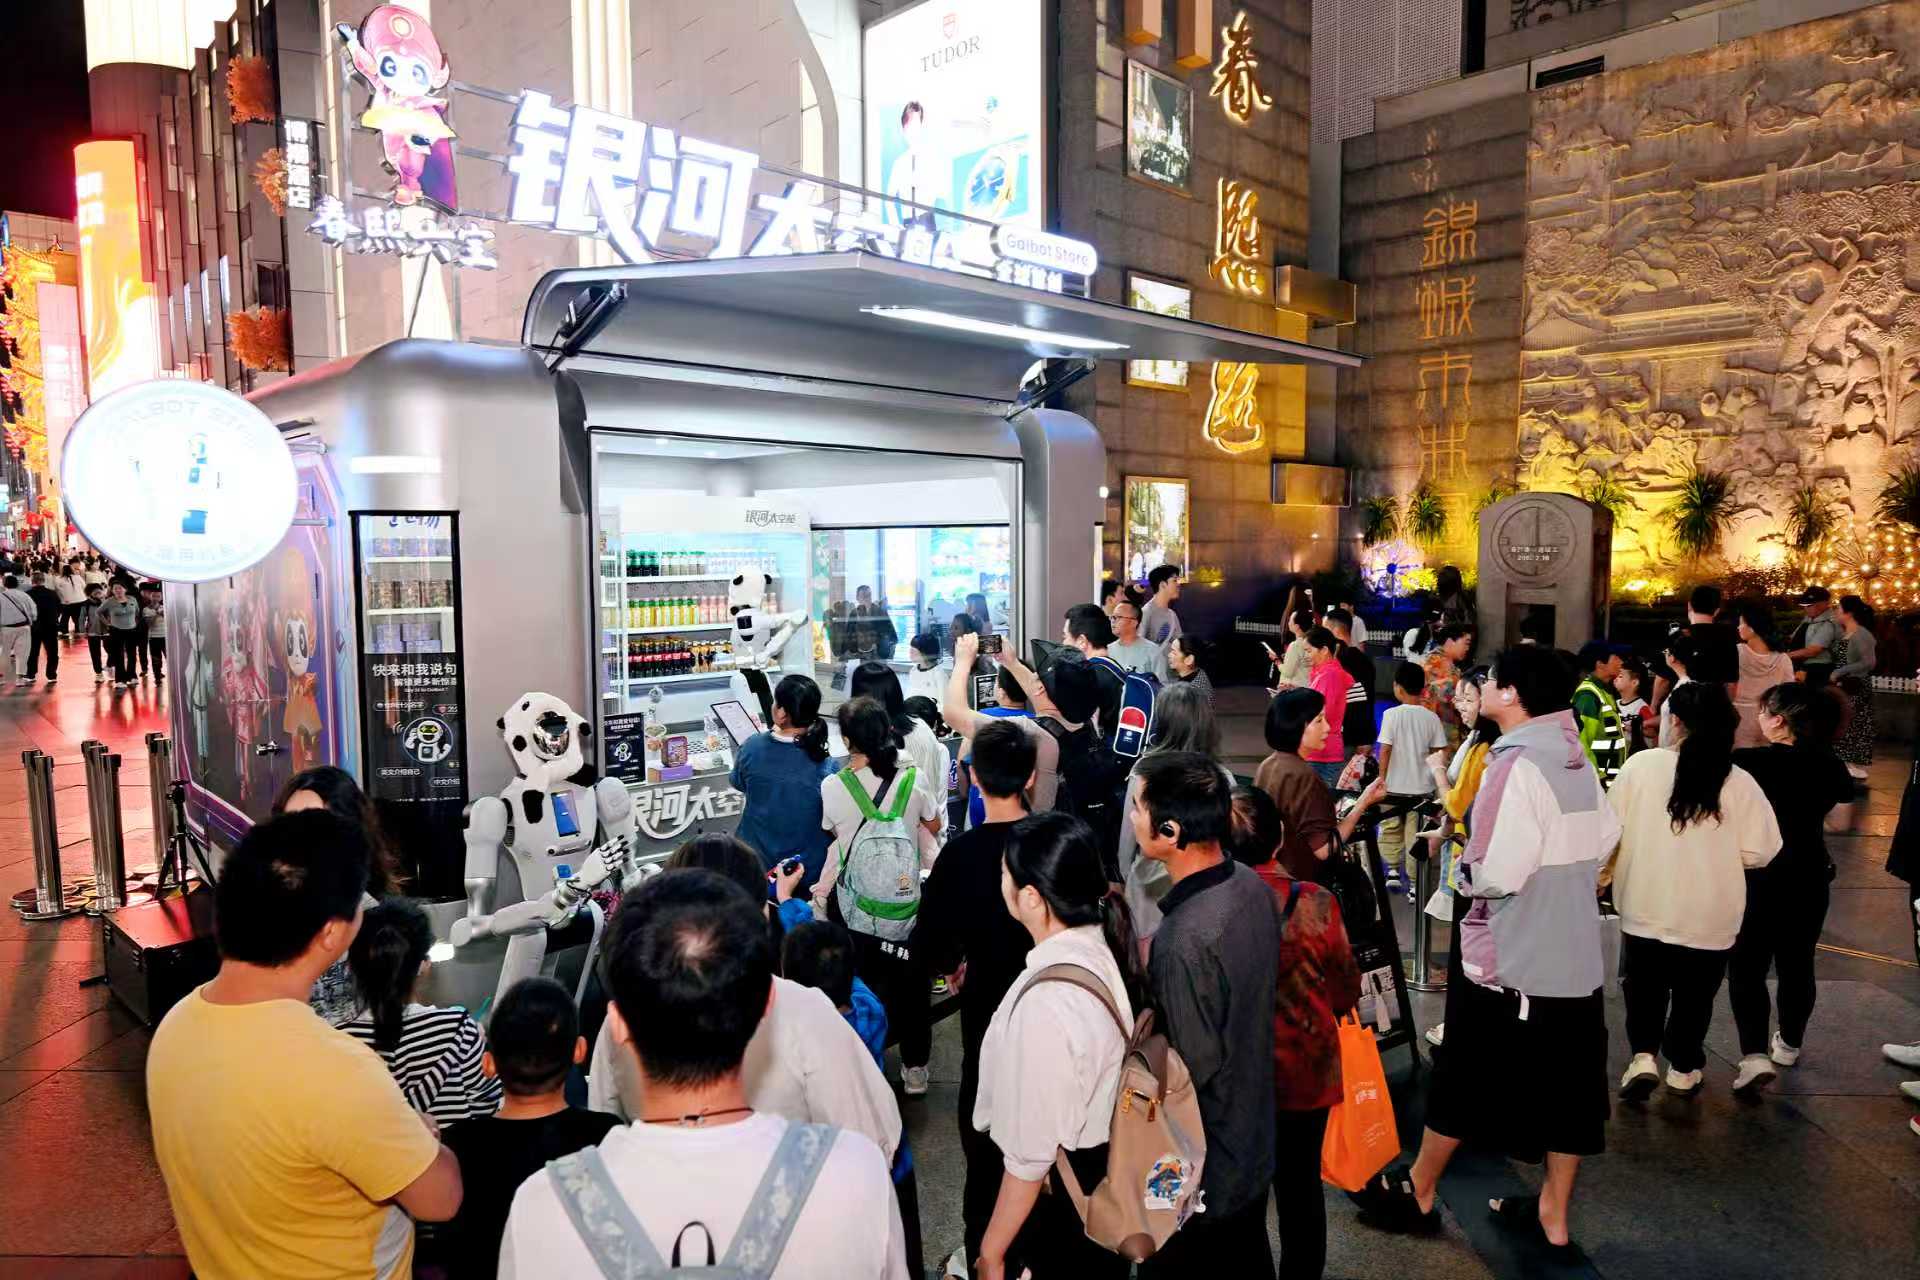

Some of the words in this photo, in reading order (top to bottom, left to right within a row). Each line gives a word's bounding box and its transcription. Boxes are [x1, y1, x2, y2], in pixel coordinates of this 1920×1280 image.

[919, 35, 981, 72] TUDOR
[1006, 233, 1051, 257] Galbot
[1055, 246, 1089, 265] Store
[744, 510, 797, 528] 银河太空舱
[372, 663, 457, 677] 快来和我说句
